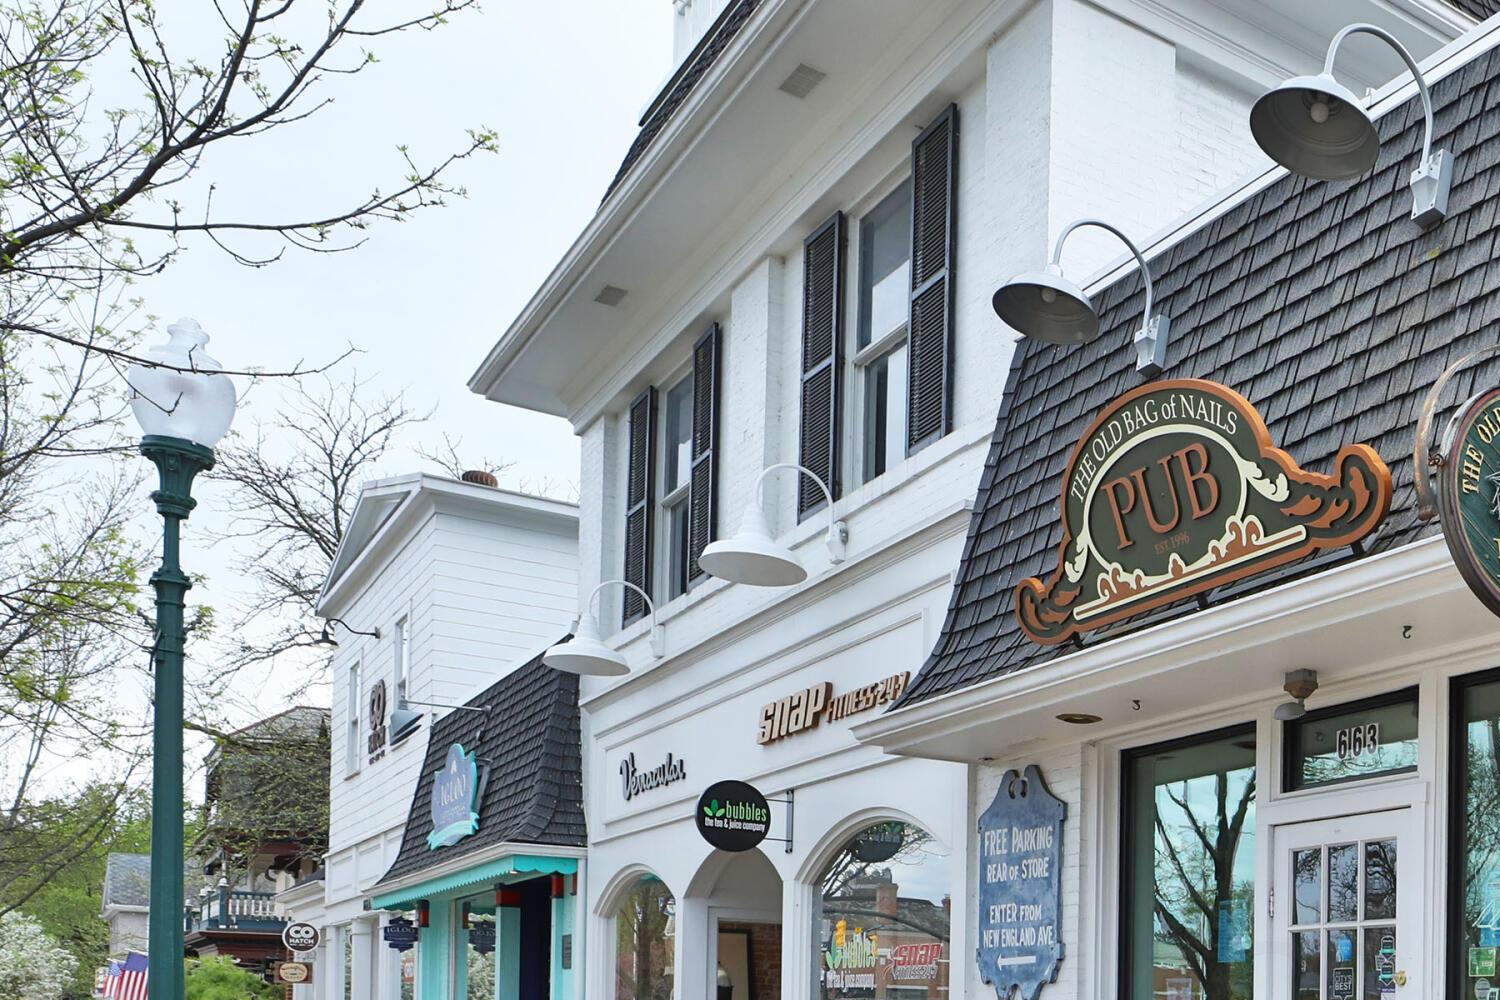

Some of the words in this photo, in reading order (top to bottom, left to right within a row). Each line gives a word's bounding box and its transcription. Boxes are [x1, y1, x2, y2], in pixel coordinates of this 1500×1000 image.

[1071, 453, 1097, 503] THE
[1092, 421, 1122, 461] OLD
[1122, 400, 1158, 435] BAG
[1161, 394, 1177, 420] of
[1179, 394, 1238, 435] NAILS
[1463, 444, 1484, 493] THE
[1102, 443, 1219, 550] PUB
[1337, 723, 1378, 760] 663
[619, 752, 686, 801] Vernacular
[704, 816, 713, 827] the
[715, 817, 723, 828] tea
[724, 818, 729, 828] &
[729, 819, 742, 830] juice
[743, 822, 766, 833] company
[726, 800, 767, 822] bubbles
[984, 828, 1008, 857] FREE
[1012, 825, 1053, 853] PARKING
[986, 862, 1008, 883] REAR
[1009, 865, 1019, 880] OF
[1021, 856, 1050, 880] STORE
[989, 902, 1017, 925] ENTER
[1020, 904, 1042, 922] FROM
[289, 926, 315, 938] CO
[983, 928, 1000, 949] NEW
[1001, 927, 1036, 948] ENGLAND
[1037, 925, 1053, 947] AVE
[1335, 982, 1351, 990] BEST
